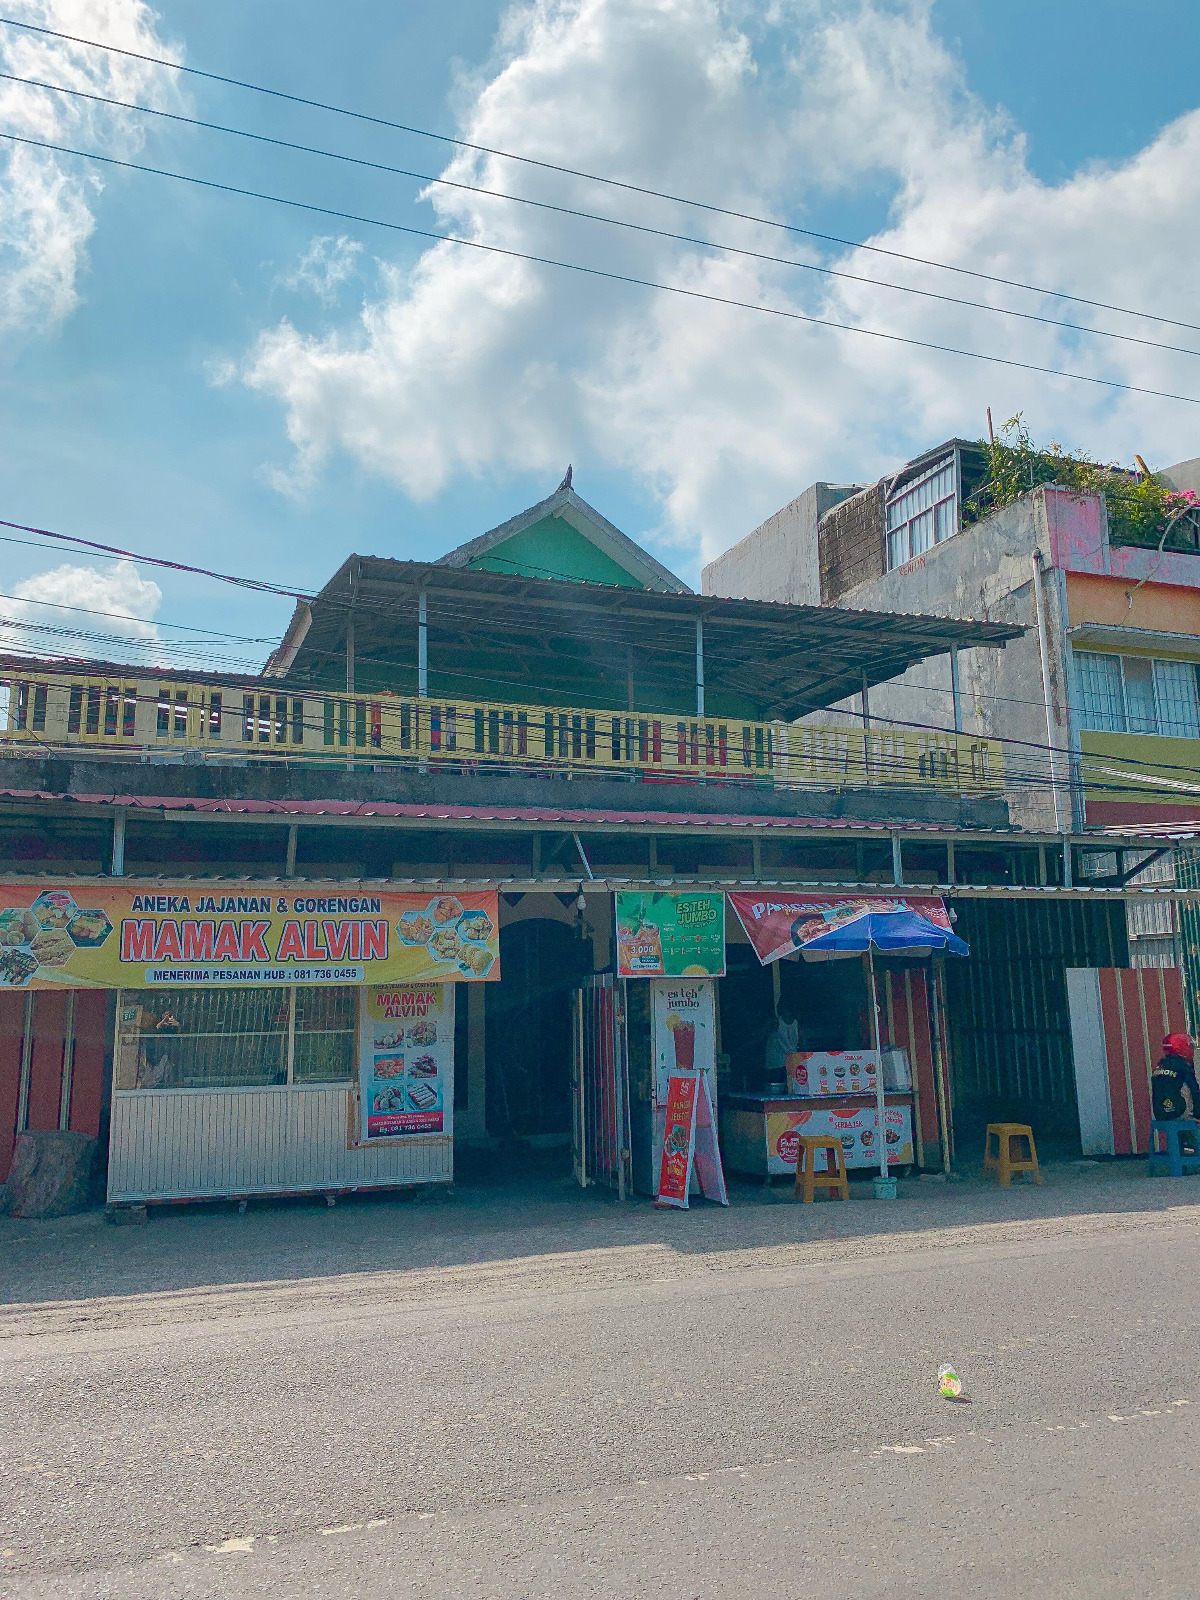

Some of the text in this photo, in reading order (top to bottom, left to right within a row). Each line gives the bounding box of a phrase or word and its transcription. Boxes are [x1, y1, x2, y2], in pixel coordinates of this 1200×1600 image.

[131, 895, 381, 914] ANEKA JAJANAN & GORENGAN
[676, 899, 711, 914] ES TEH
[677, 908, 717, 925] JUMBO
[120, 918, 389, 962] MAMAK ALVIN
[630, 945, 654, 954] 3.000
[153, 969, 210, 981] MENERIMA
[212, 969, 262, 980] PESANAN
[264, 969, 286, 980] HUB
[293, 968, 312, 979] 081
[313, 968, 332, 979] 736
[334, 968, 357, 979] 0455
[377, 991, 436, 1007] MAMAK
[667, 988, 698, 998] es teh
[384, 1004, 429, 1018] ALVIN
[667, 998, 700, 1010] jumbo
[834, 1121, 852, 1129] SERBA
